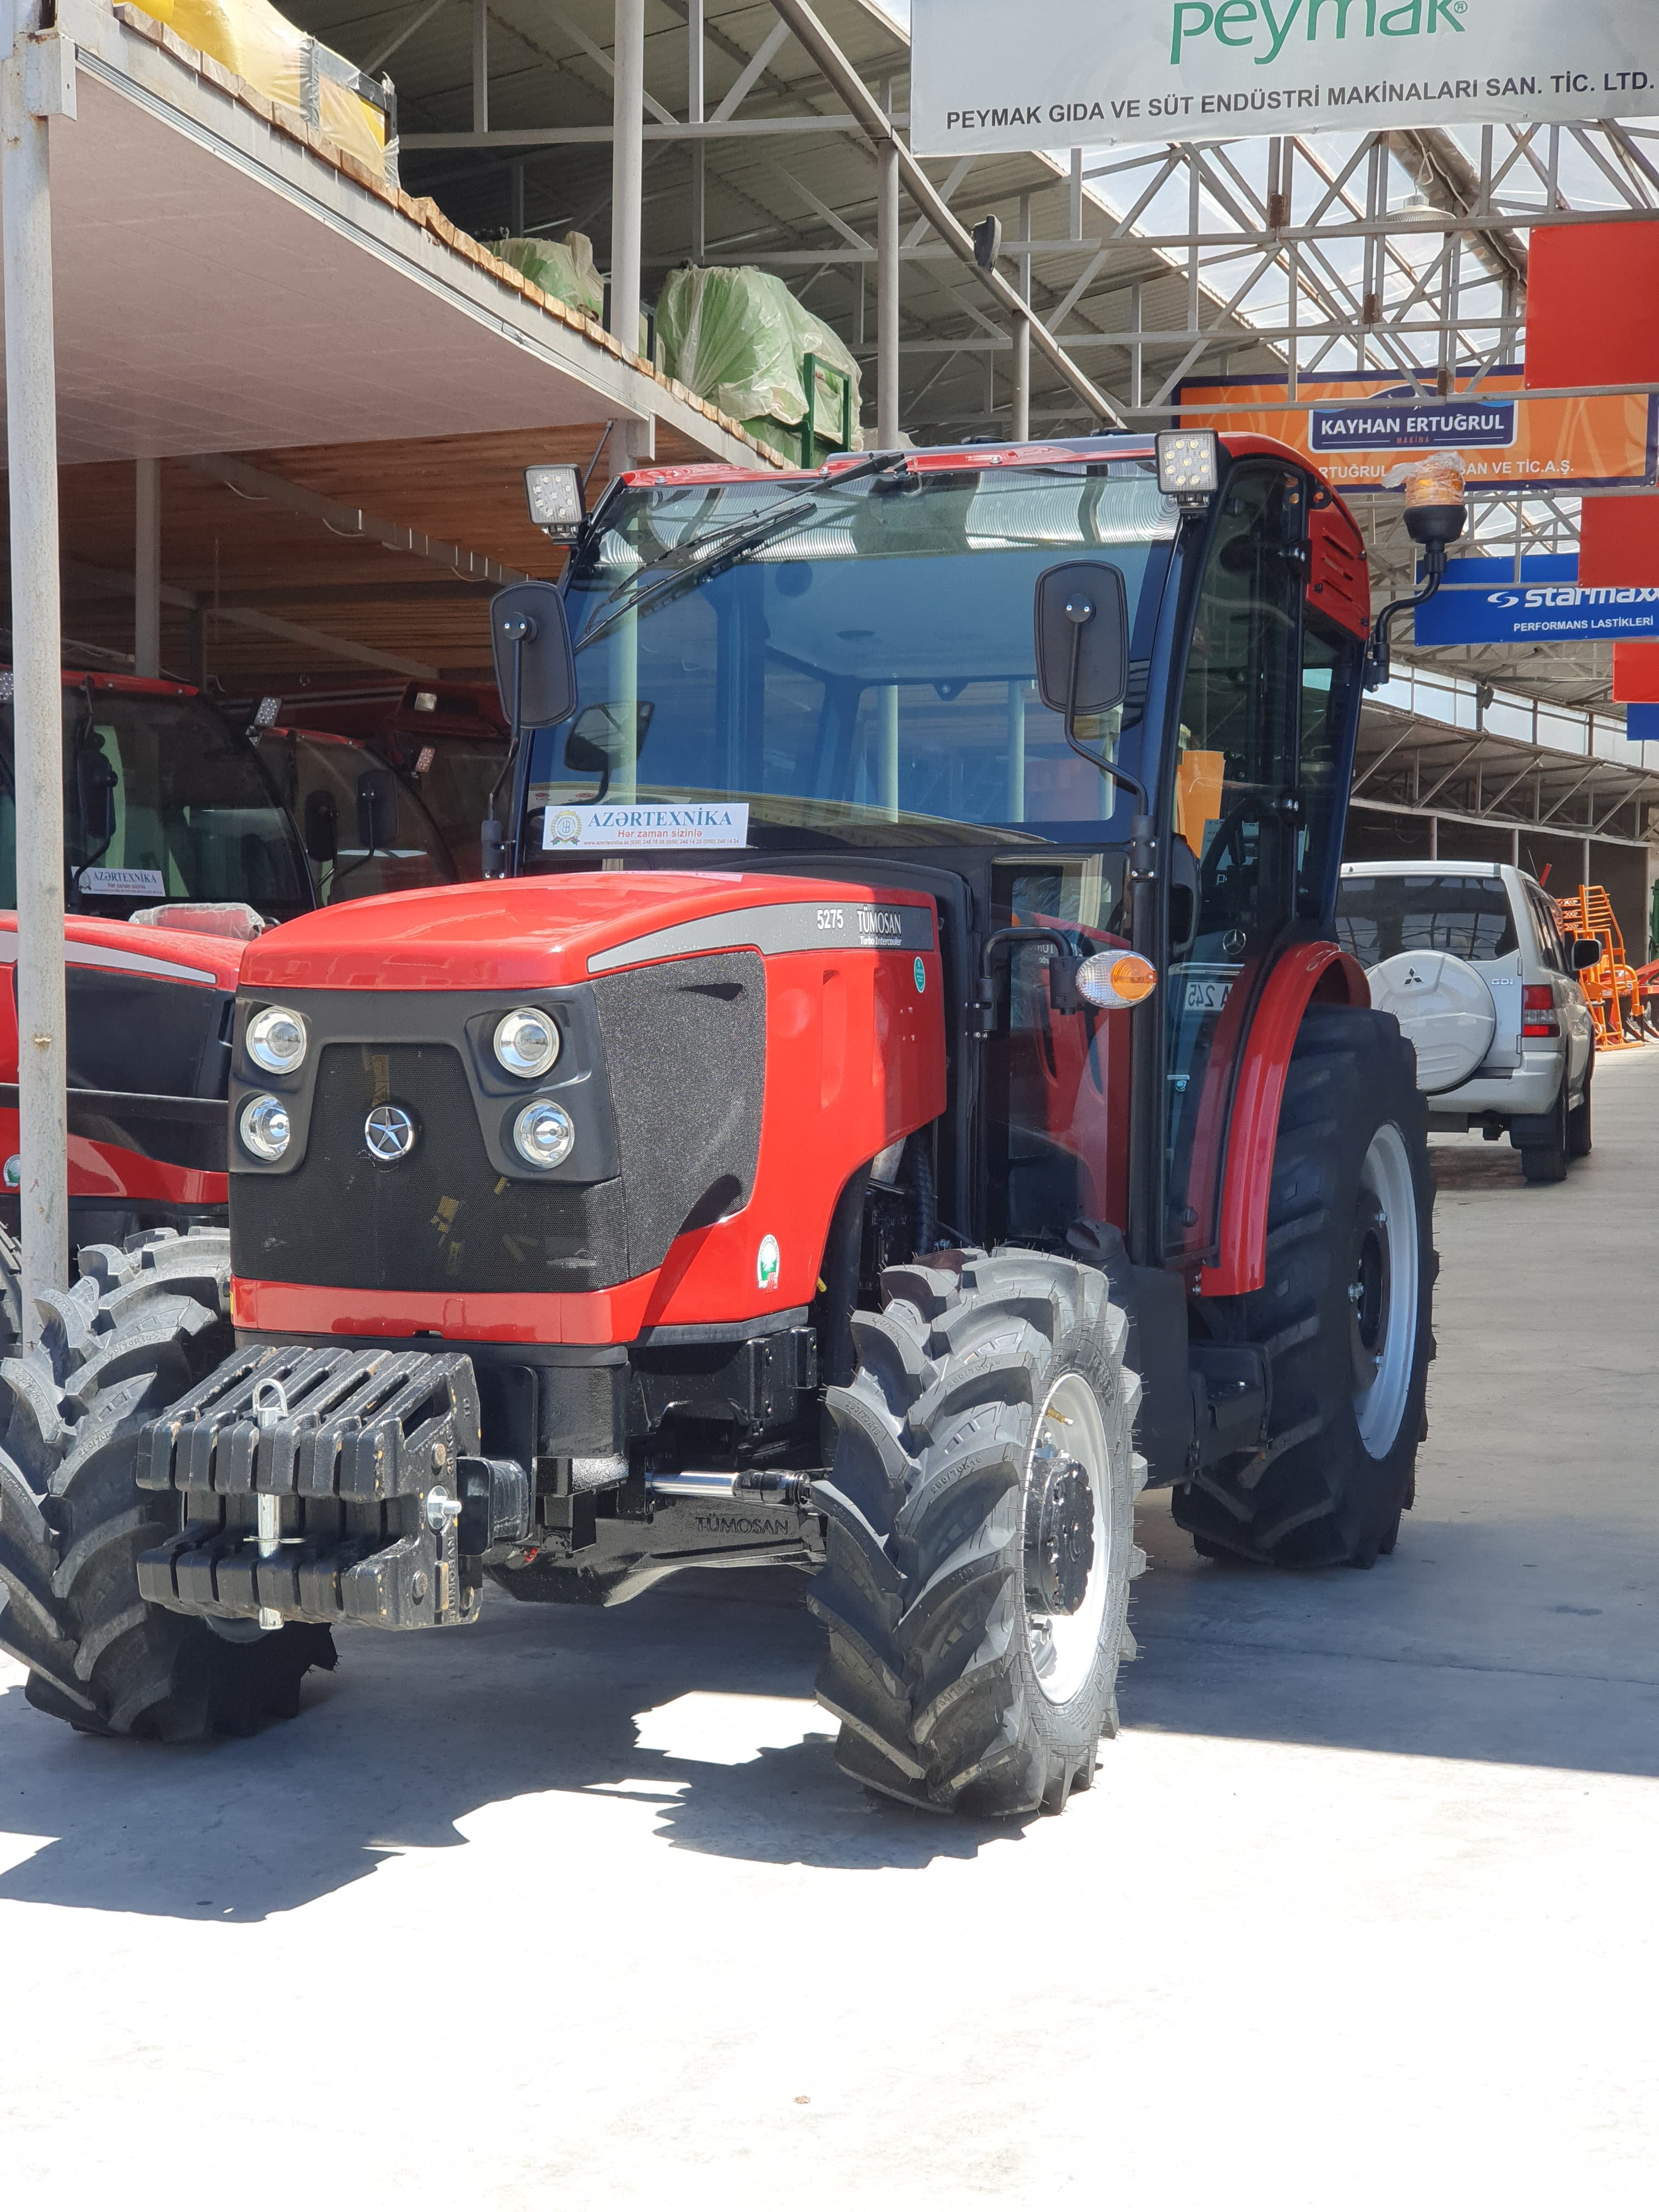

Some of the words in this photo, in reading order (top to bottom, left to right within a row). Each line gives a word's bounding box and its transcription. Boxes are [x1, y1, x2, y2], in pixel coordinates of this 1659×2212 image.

[947, 105, 1041, 129] PEYMAK
[1048, 102, 1104, 123] GIDA
[1110, 100, 1141, 118] VE
[1148, 94, 1193, 116] SÜT
[1201, 84, 1319, 114] ENDÜSTRİ
[1327, 80, 1477, 106] MAKİNALARI
[1486, 76, 1542, 97] SAN.
[1550, 71, 1595, 93] TİC.
[1604, 71, 1655, 91] LTD.
[1321, 417, 1400, 436] KAYHAN
[1406, 413, 1504, 433] ERTUĞRUL
[1318, 463, 1386, 479] RTUĞRUL
[1492, 461, 1511, 474] VE
[1516, 459, 1574, 475] TİC.A.Ş.
[1514, 620, 1588, 632] PERFORMANS
[1591, 615, 1654, 628] LASTİKLERİ
[588, 808, 732, 827] AZƏRTEXNİKA
[618, 829, 635, 838] Hər
[671, 829, 703, 838] sizinlə
[817, 909, 844, 930] 5275
[857, 906, 902, 934] TÜMOSAN
[860, 935, 875, 945] Turbo
[875, 936, 902, 946] Intercooler
[695, 1514, 789, 1536] TÜMOSAN
